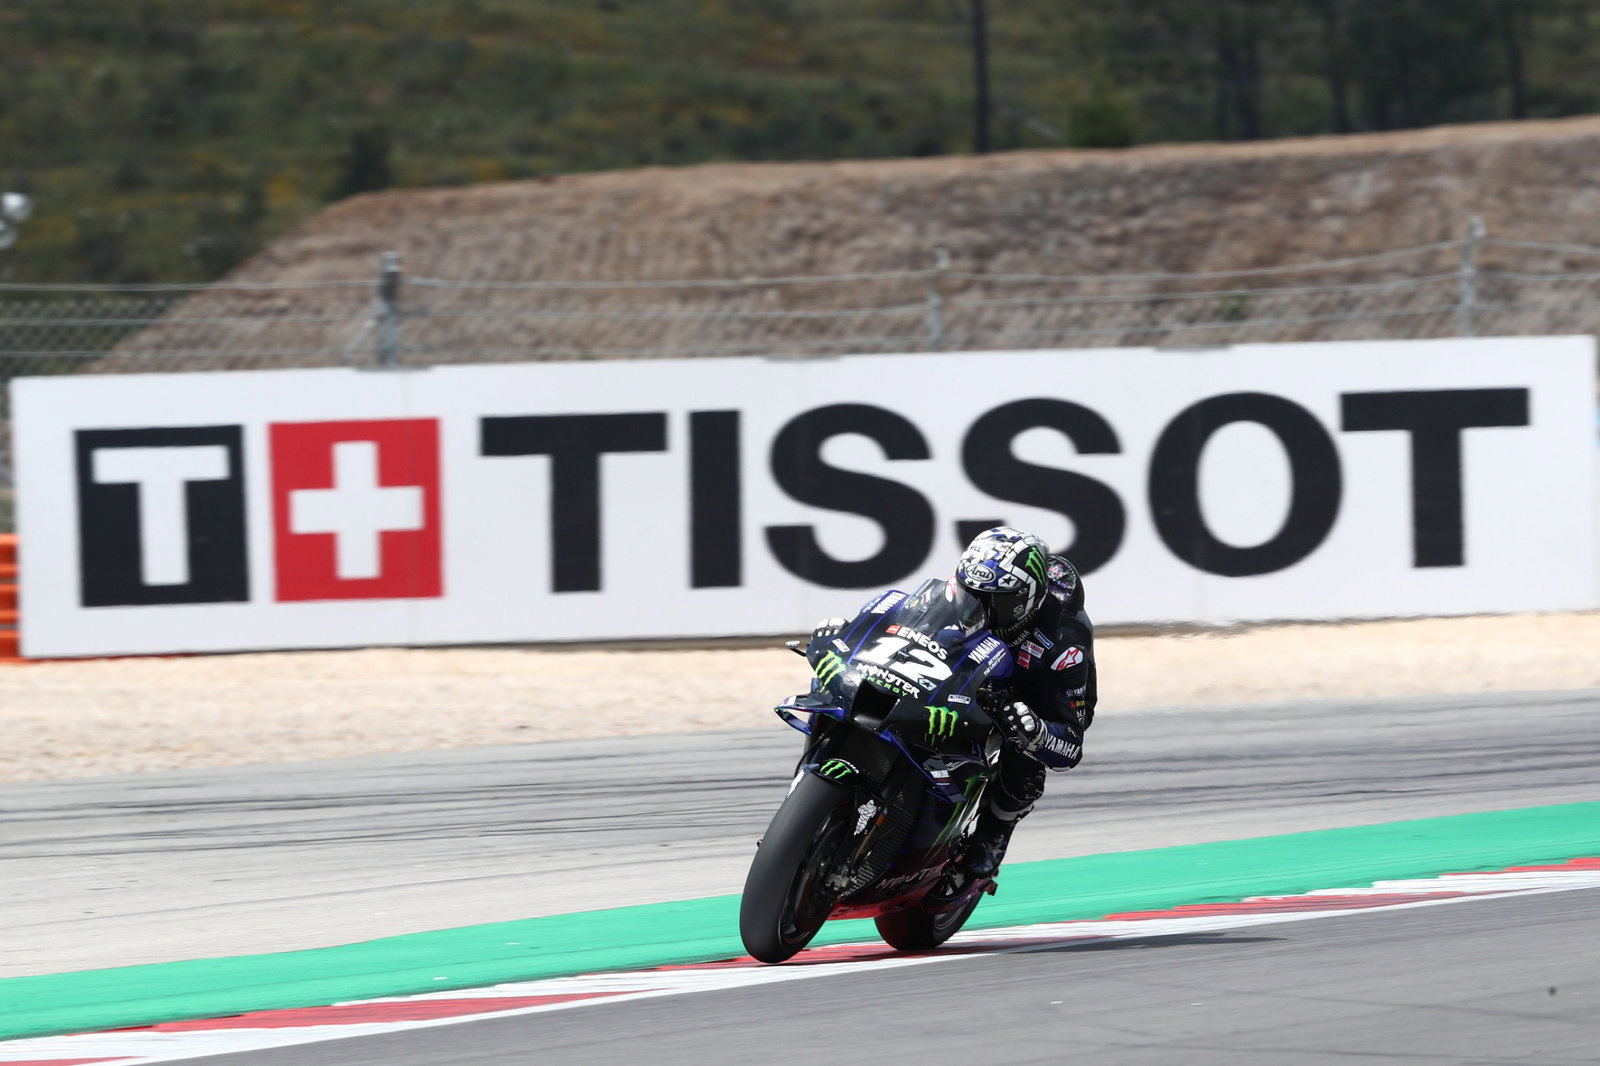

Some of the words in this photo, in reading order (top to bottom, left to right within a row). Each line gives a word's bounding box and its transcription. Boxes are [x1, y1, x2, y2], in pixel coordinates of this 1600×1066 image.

[479, 386, 1530, 593] TISSOT
[966, 566, 991, 580] Arai
[897, 626, 948, 660] ENEOS
[968, 636, 1001, 665] YAMAHA
[853, 636, 953, 683] 12
[856, 662, 920, 699] MONSTER
[860, 673, 910, 697] ENERGY
[1045, 733, 1080, 760] YAMAHA
